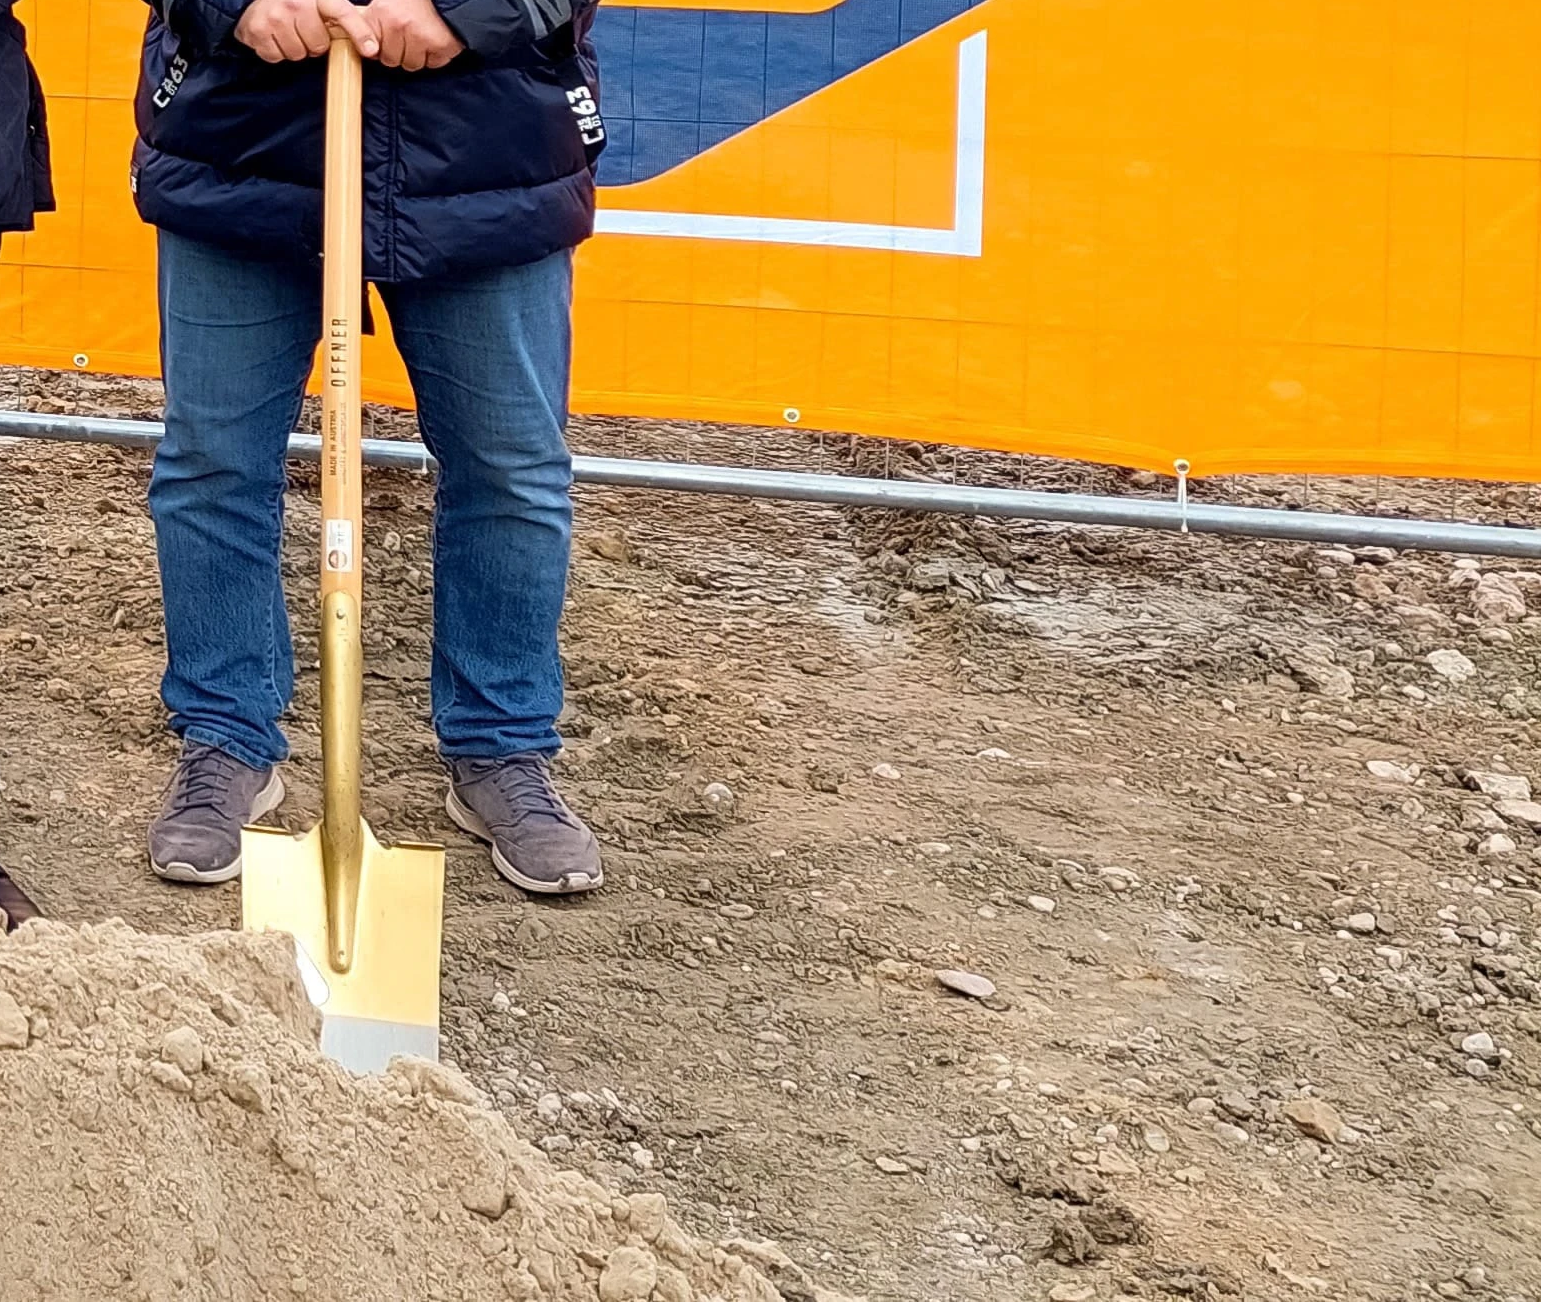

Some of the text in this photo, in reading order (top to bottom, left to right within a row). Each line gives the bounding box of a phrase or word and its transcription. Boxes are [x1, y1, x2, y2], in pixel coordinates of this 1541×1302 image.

[330, 317, 349, 388] OFFNER
[329, 409, 337, 476] MADE IN AUSTRIA
